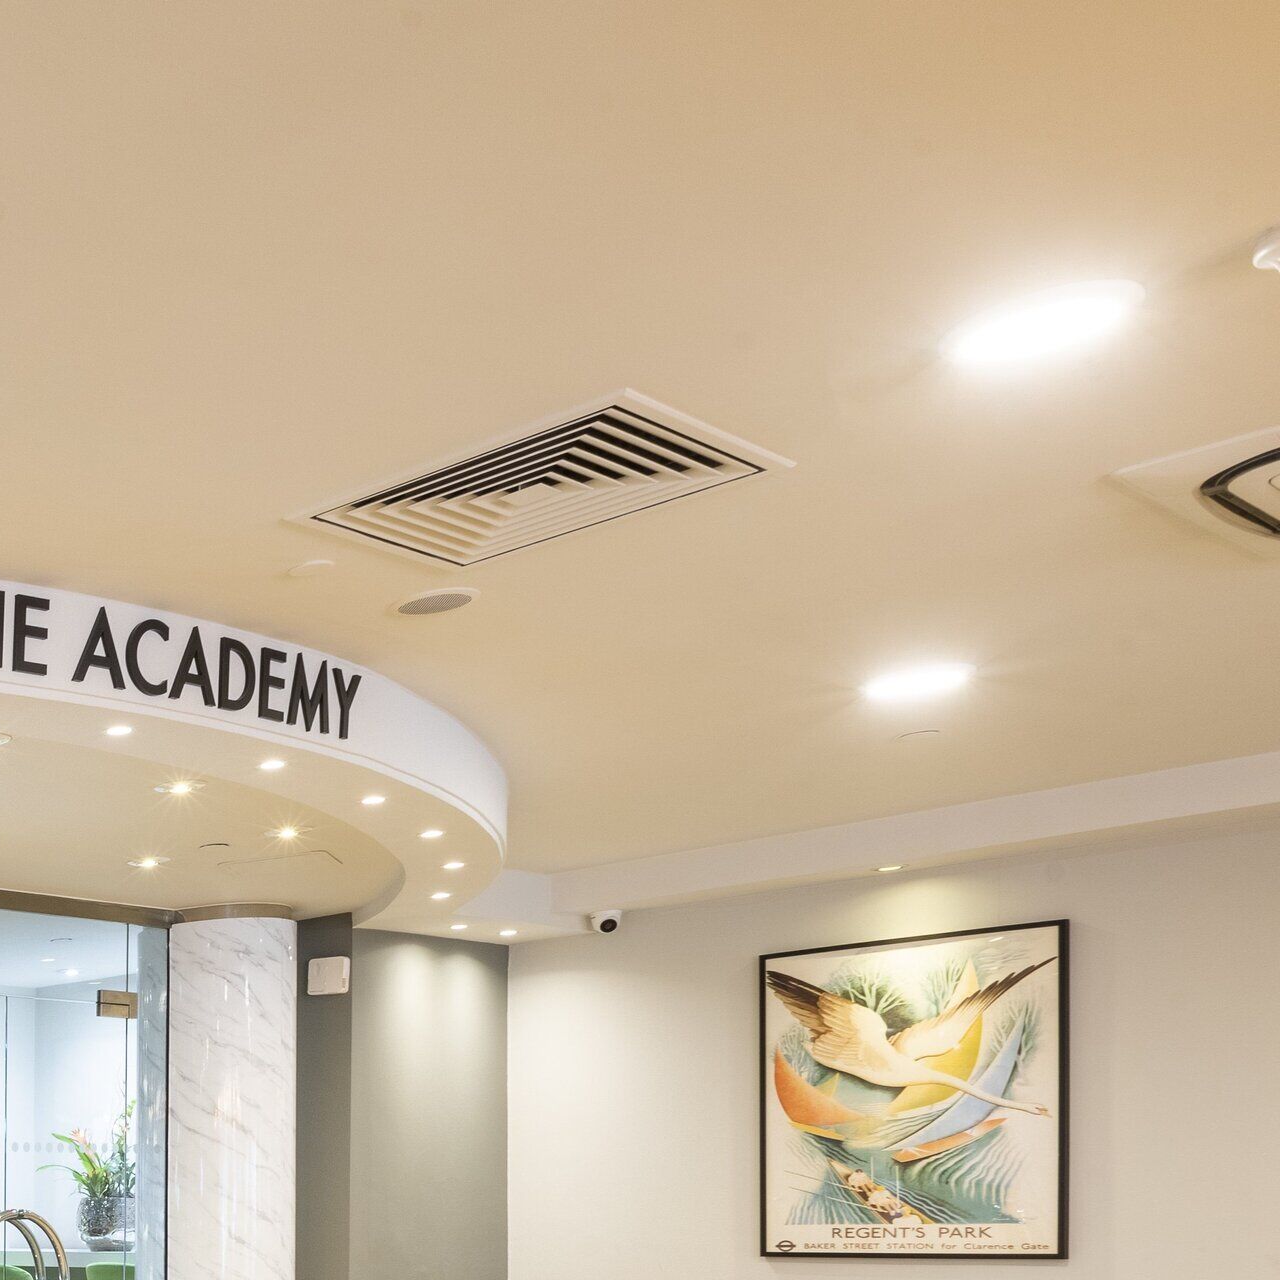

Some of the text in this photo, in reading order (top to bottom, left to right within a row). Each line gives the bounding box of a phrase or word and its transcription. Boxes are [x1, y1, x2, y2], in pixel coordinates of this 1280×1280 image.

[71, 606, 362, 740] ACADEMY
[831, 1226, 993, 1239] REGENT'S PARK
[804, 1242, 1049, 1250] BAKER STREET STATION for Clarence Gate
